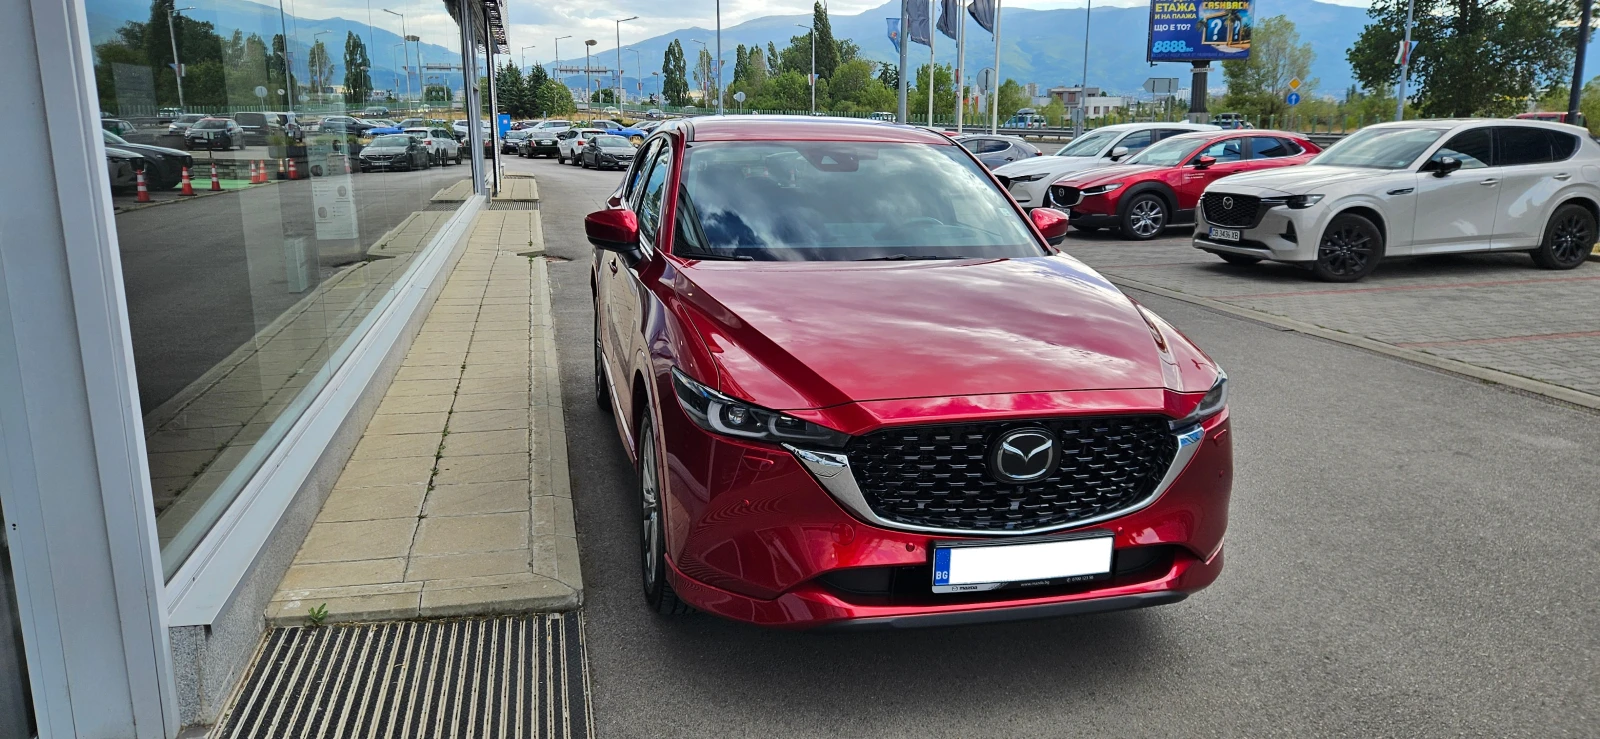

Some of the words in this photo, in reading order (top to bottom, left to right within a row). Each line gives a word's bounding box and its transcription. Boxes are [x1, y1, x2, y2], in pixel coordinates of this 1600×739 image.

[1155, 3, 1196, 12] ЕТАЖА
[1203, 1, 1249, 10] CASHBACK
[1154, 24, 1169, 32] ЩО
[1176, 23, 1191, 31] ТО?
[935, 570, 948, 580] BG
